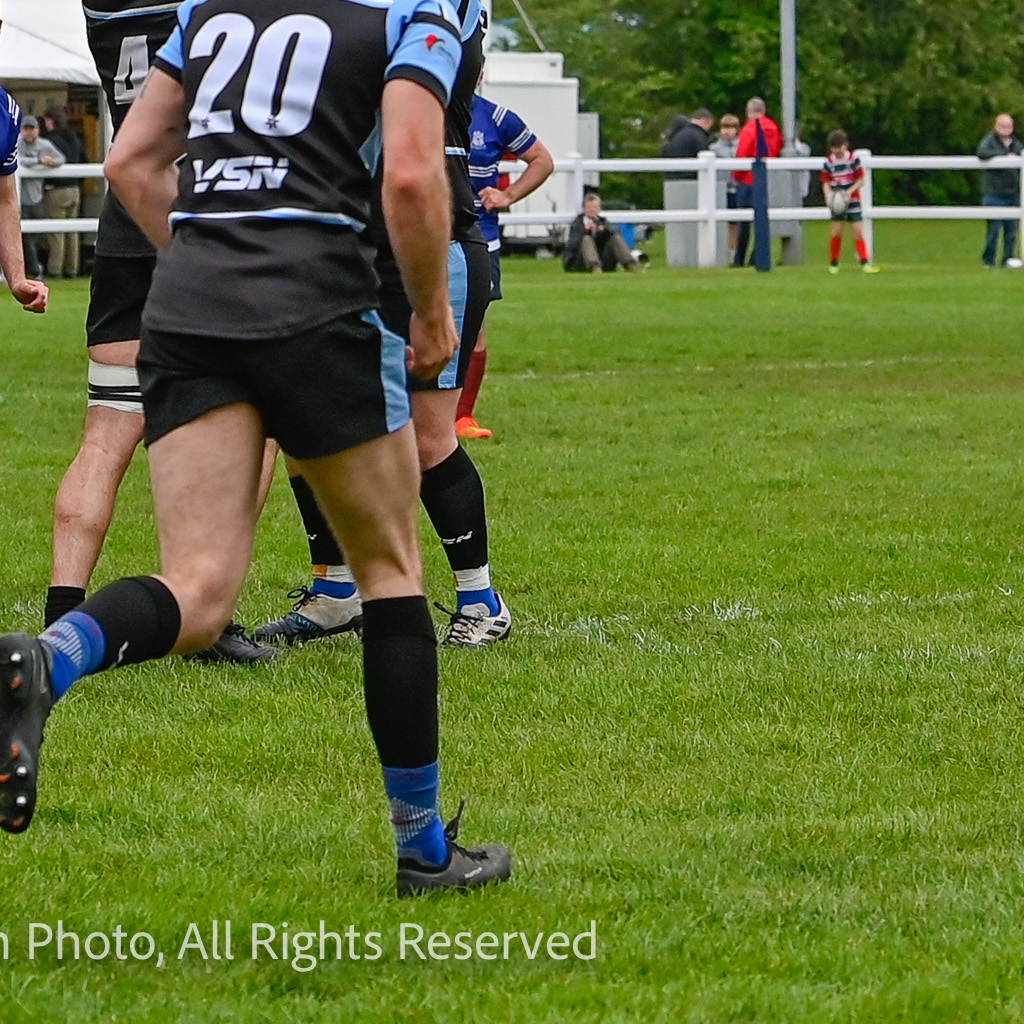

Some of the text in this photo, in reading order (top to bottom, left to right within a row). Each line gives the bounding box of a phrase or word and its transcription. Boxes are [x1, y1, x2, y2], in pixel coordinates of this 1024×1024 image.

[114, 35, 149, 105] 4
[187, 13, 332, 139] 20
[192, 156, 290, 194] VSN
